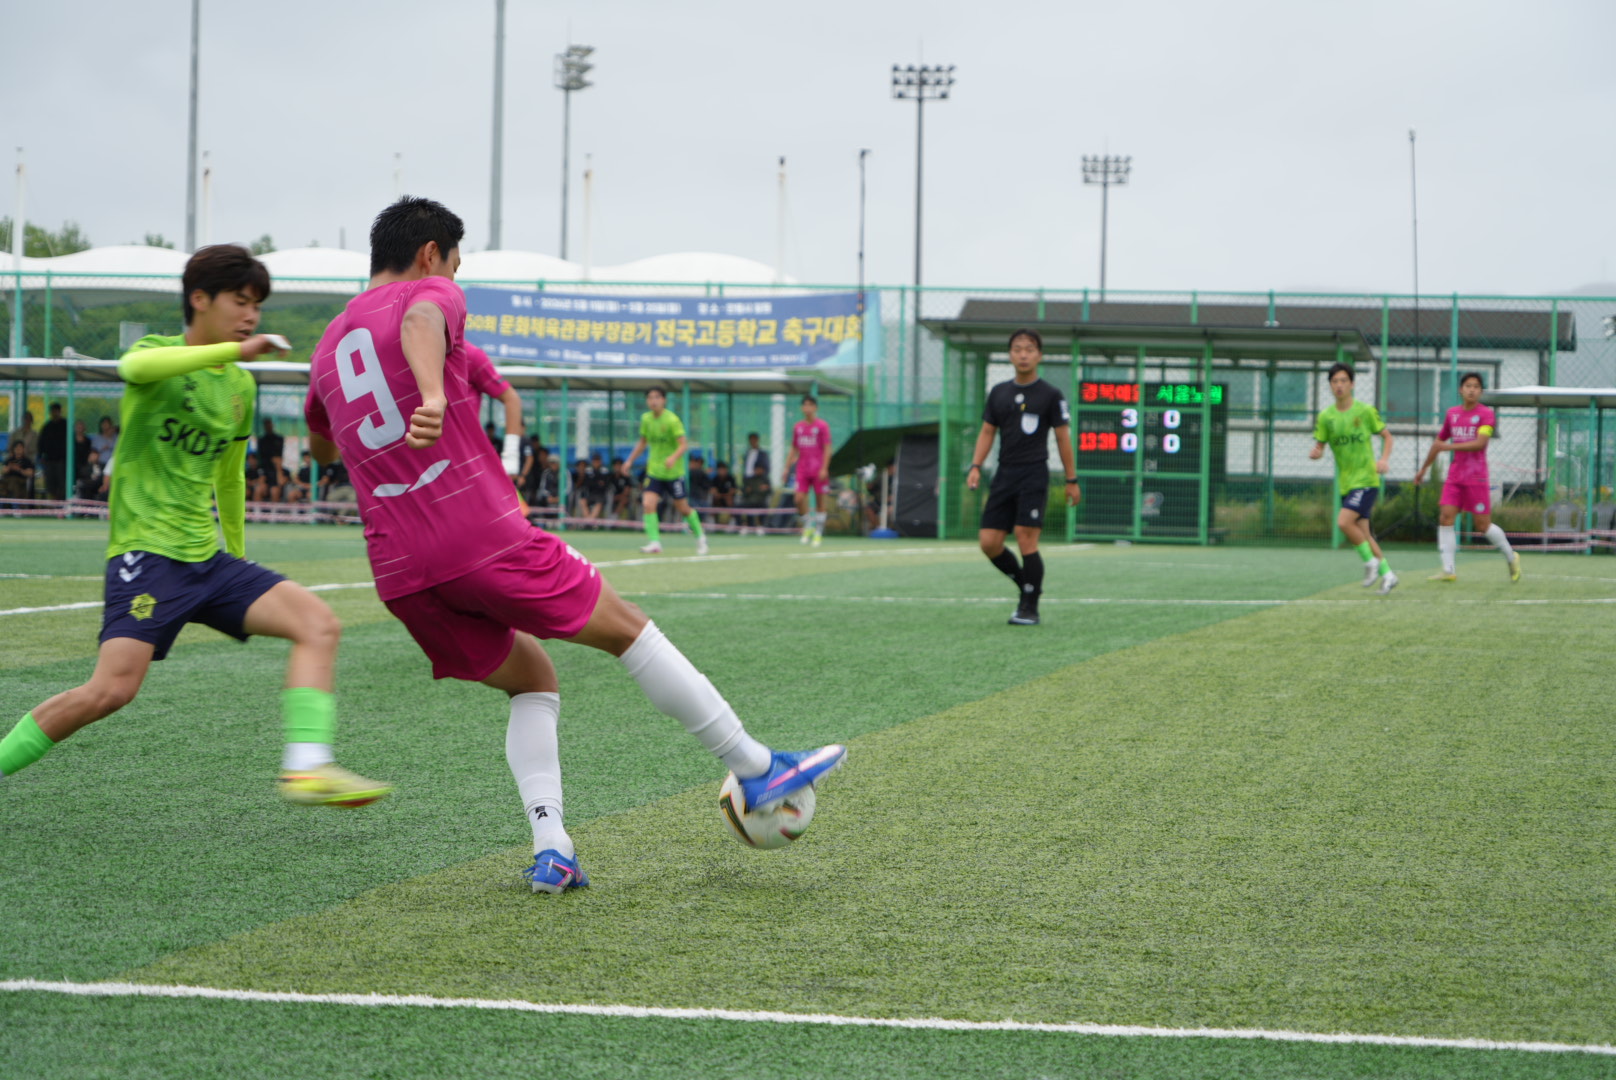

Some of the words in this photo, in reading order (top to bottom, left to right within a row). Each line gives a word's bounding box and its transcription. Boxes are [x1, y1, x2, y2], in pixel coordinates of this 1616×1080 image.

[501, 314, 652, 344] 문화체육관광부장관기
[655, 318, 777, 347] 전국고등학교
[782, 314, 862, 346] 축구대회
[335, 327, 406, 450] 9
[1121, 408, 1138, 428] 3
[1163, 409, 1180, 429] 0
[159, 418, 211, 455] SKD
[1120, 432, 1138, 453] 0
[1162, 433, 1180, 453] 0
